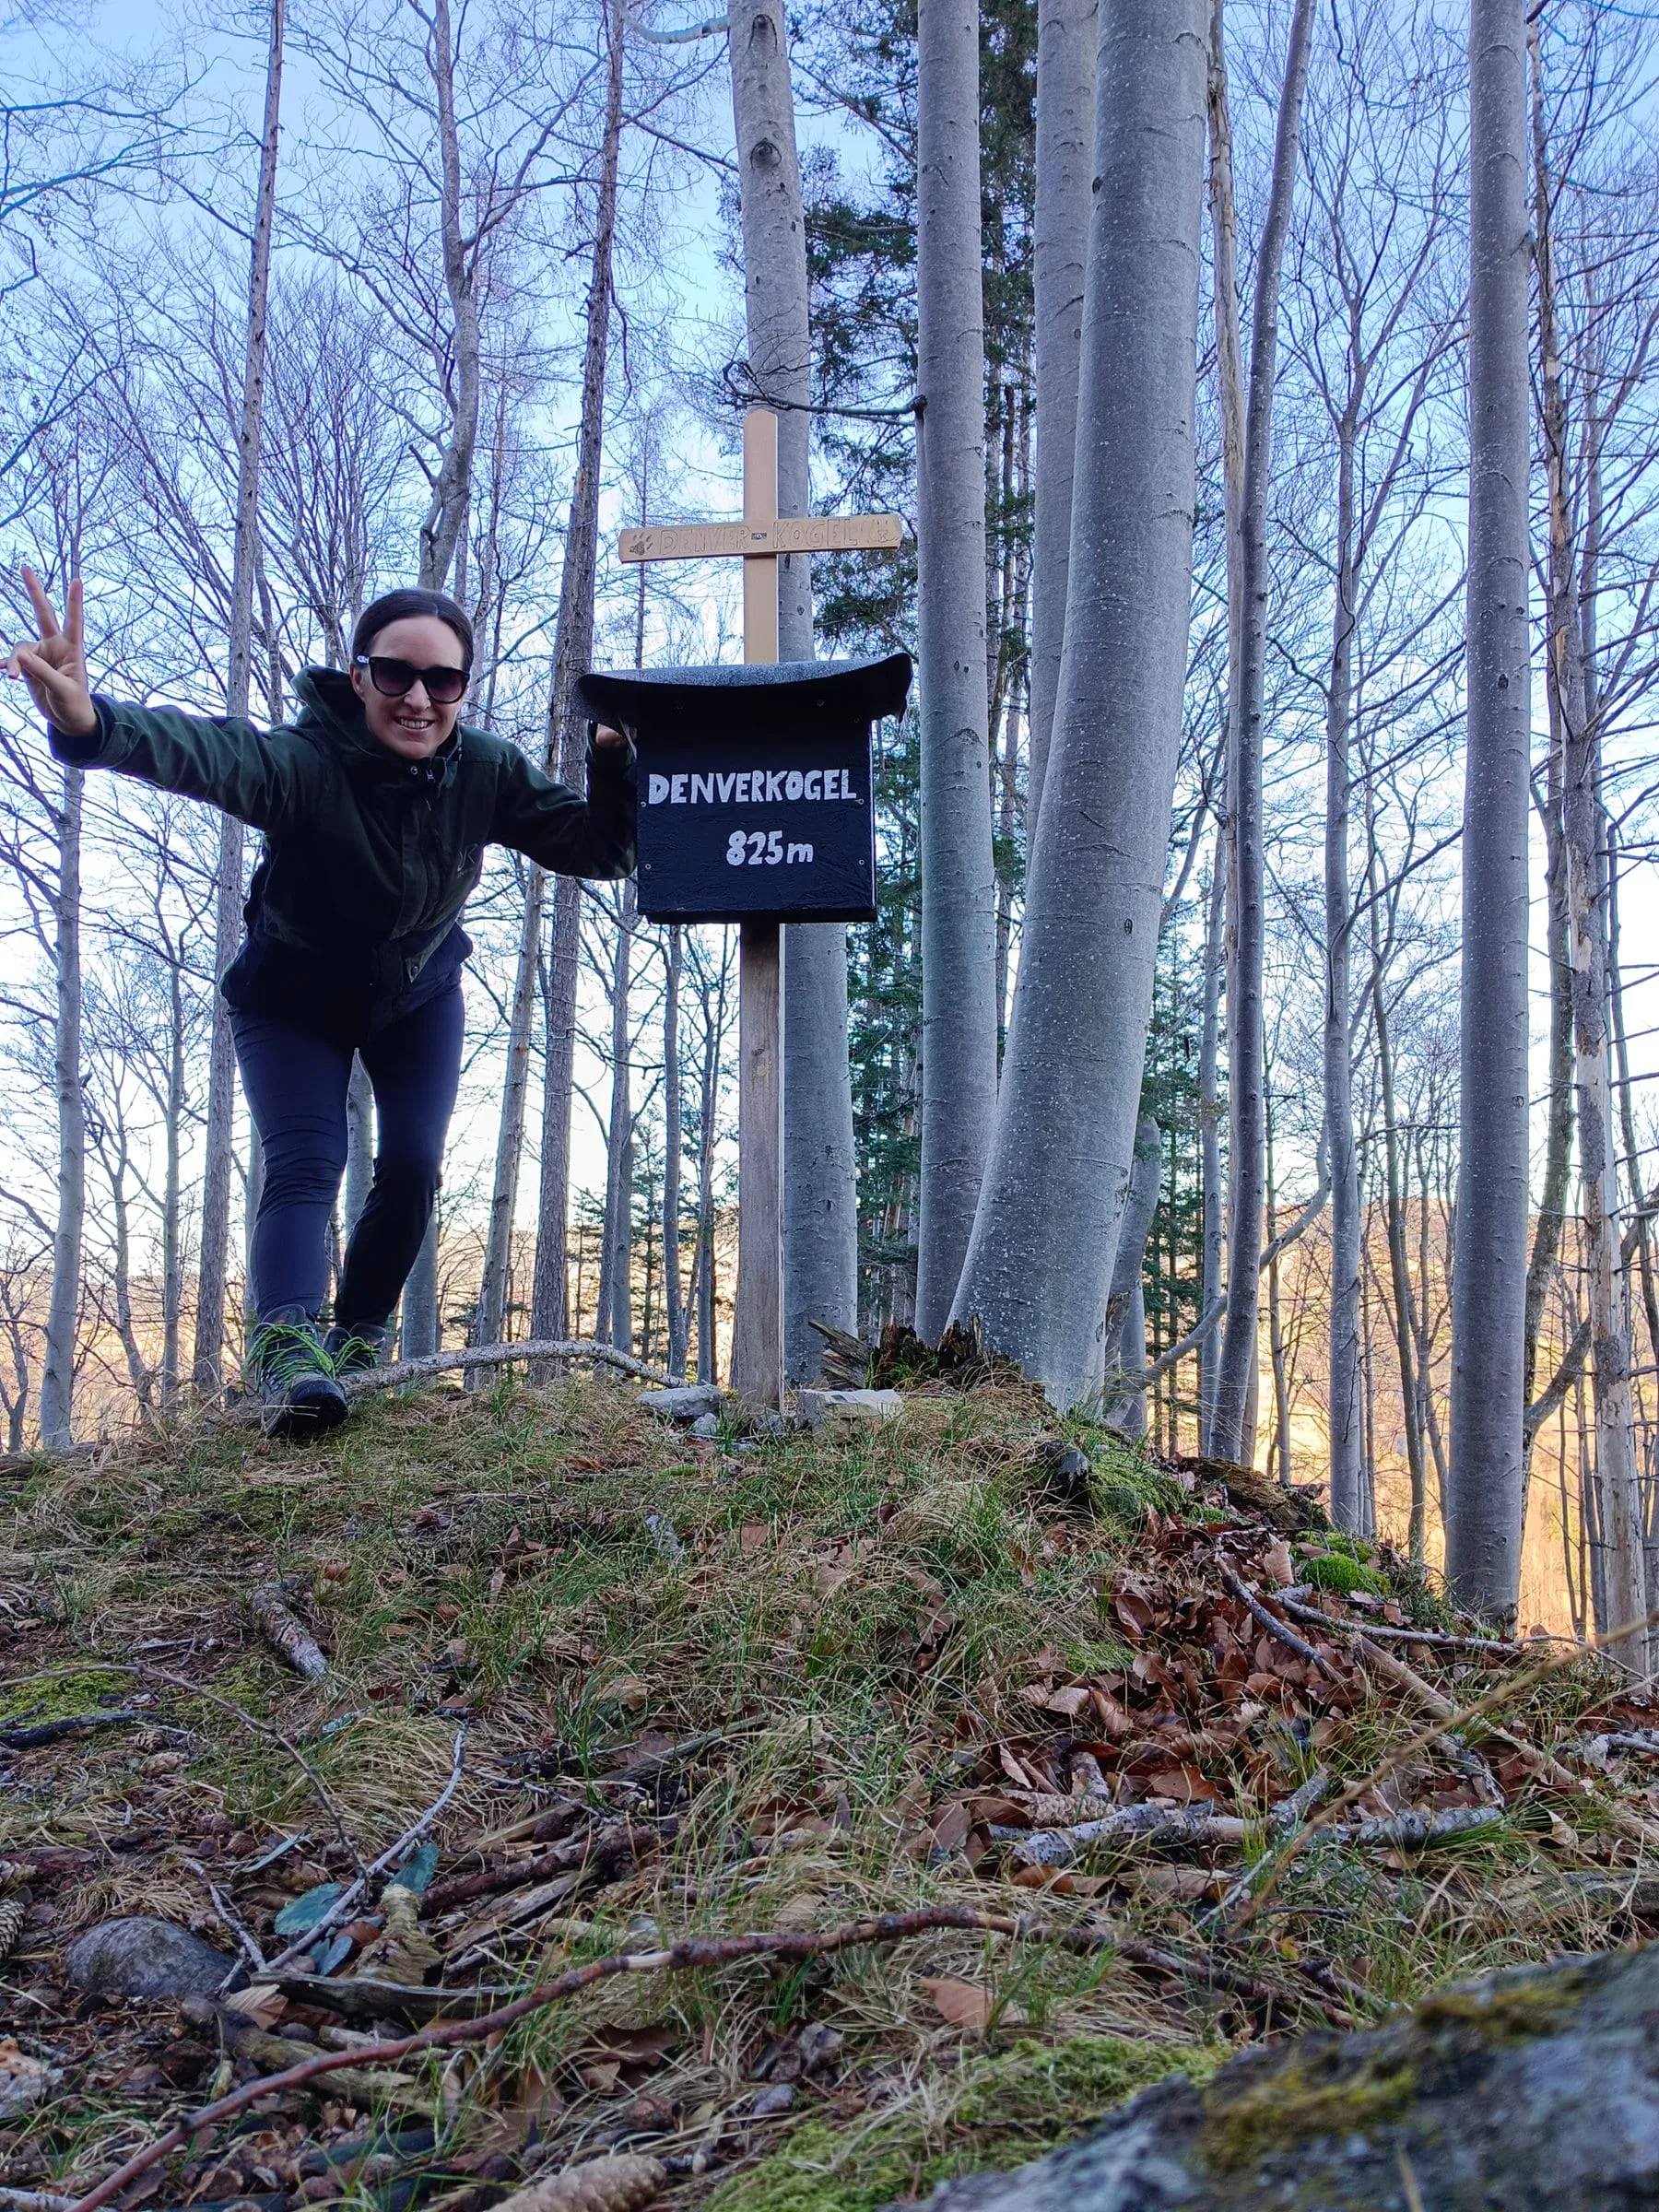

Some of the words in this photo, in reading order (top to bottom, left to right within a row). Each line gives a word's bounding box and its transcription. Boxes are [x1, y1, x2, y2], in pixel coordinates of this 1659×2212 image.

[660, 524, 751, 555] DENVER
[772, 519, 858, 549] KOGEL
[648, 769, 857, 805] DENVERKOGEL
